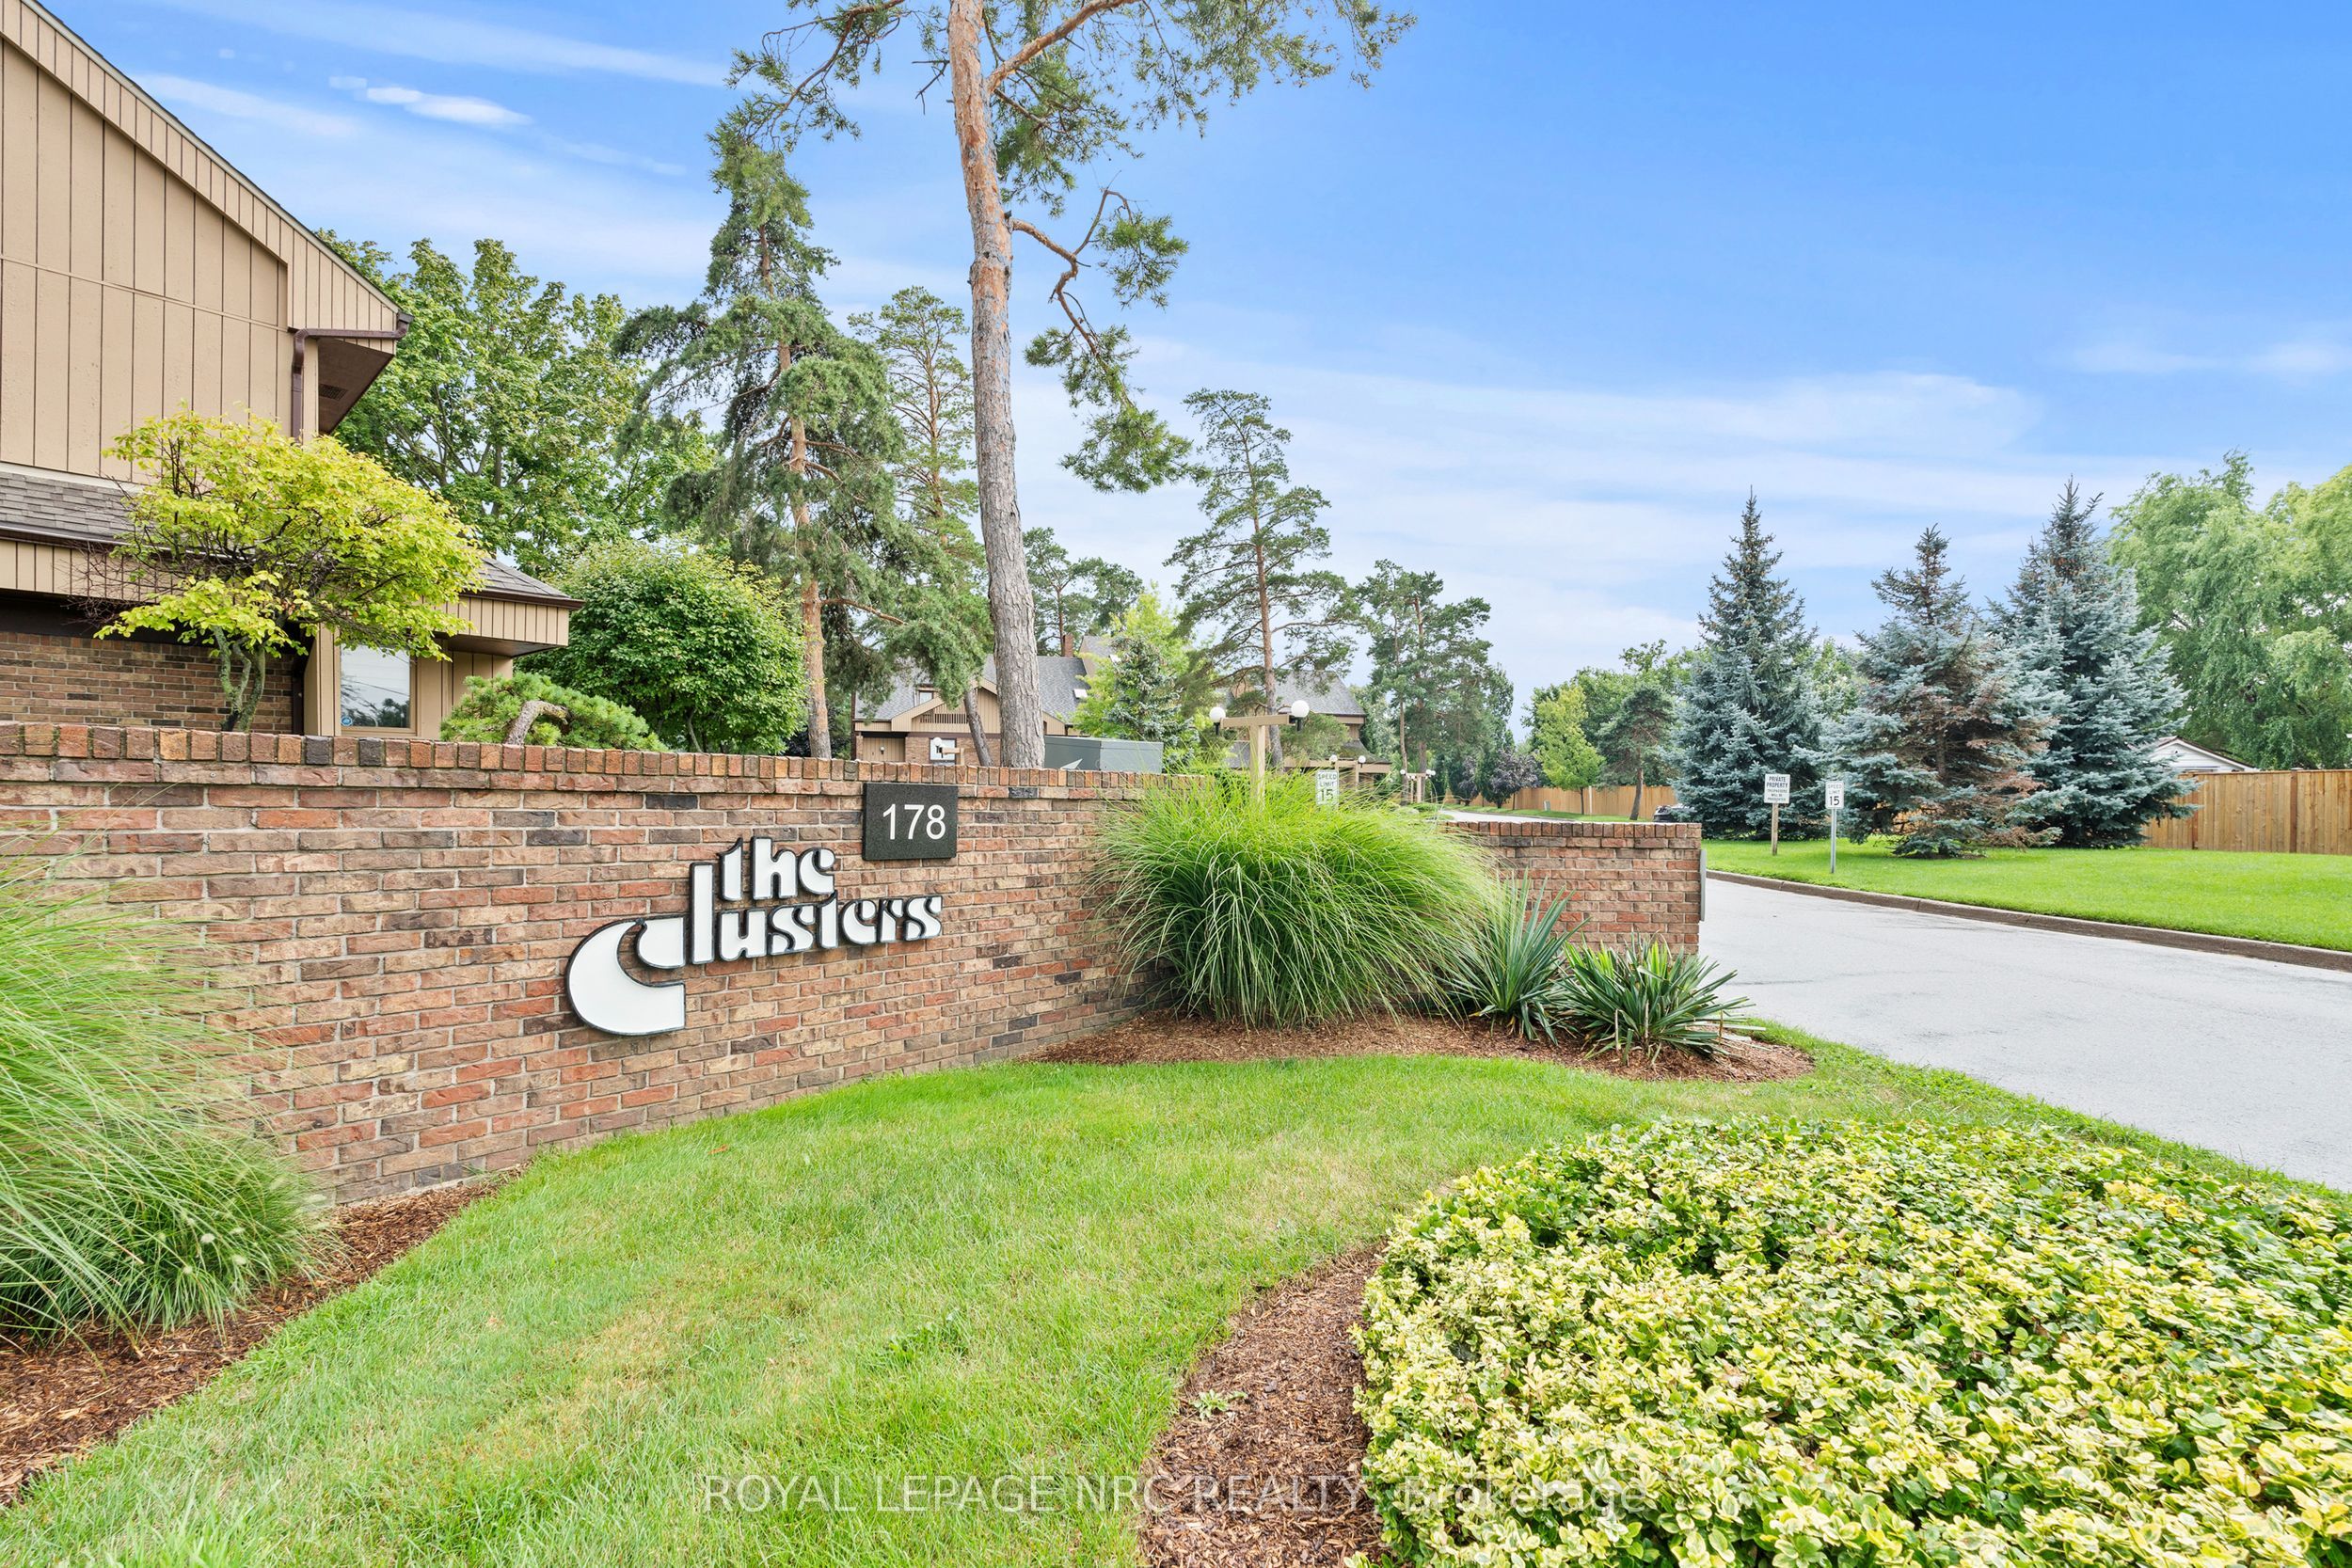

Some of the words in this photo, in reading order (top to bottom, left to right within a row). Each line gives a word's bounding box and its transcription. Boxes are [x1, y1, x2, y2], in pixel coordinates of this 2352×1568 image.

[1321, 788, 1333, 800] 15
[1829, 795, 1840, 805] 15
[882, 803, 946, 841] 178
[717, 835, 836, 901] the
